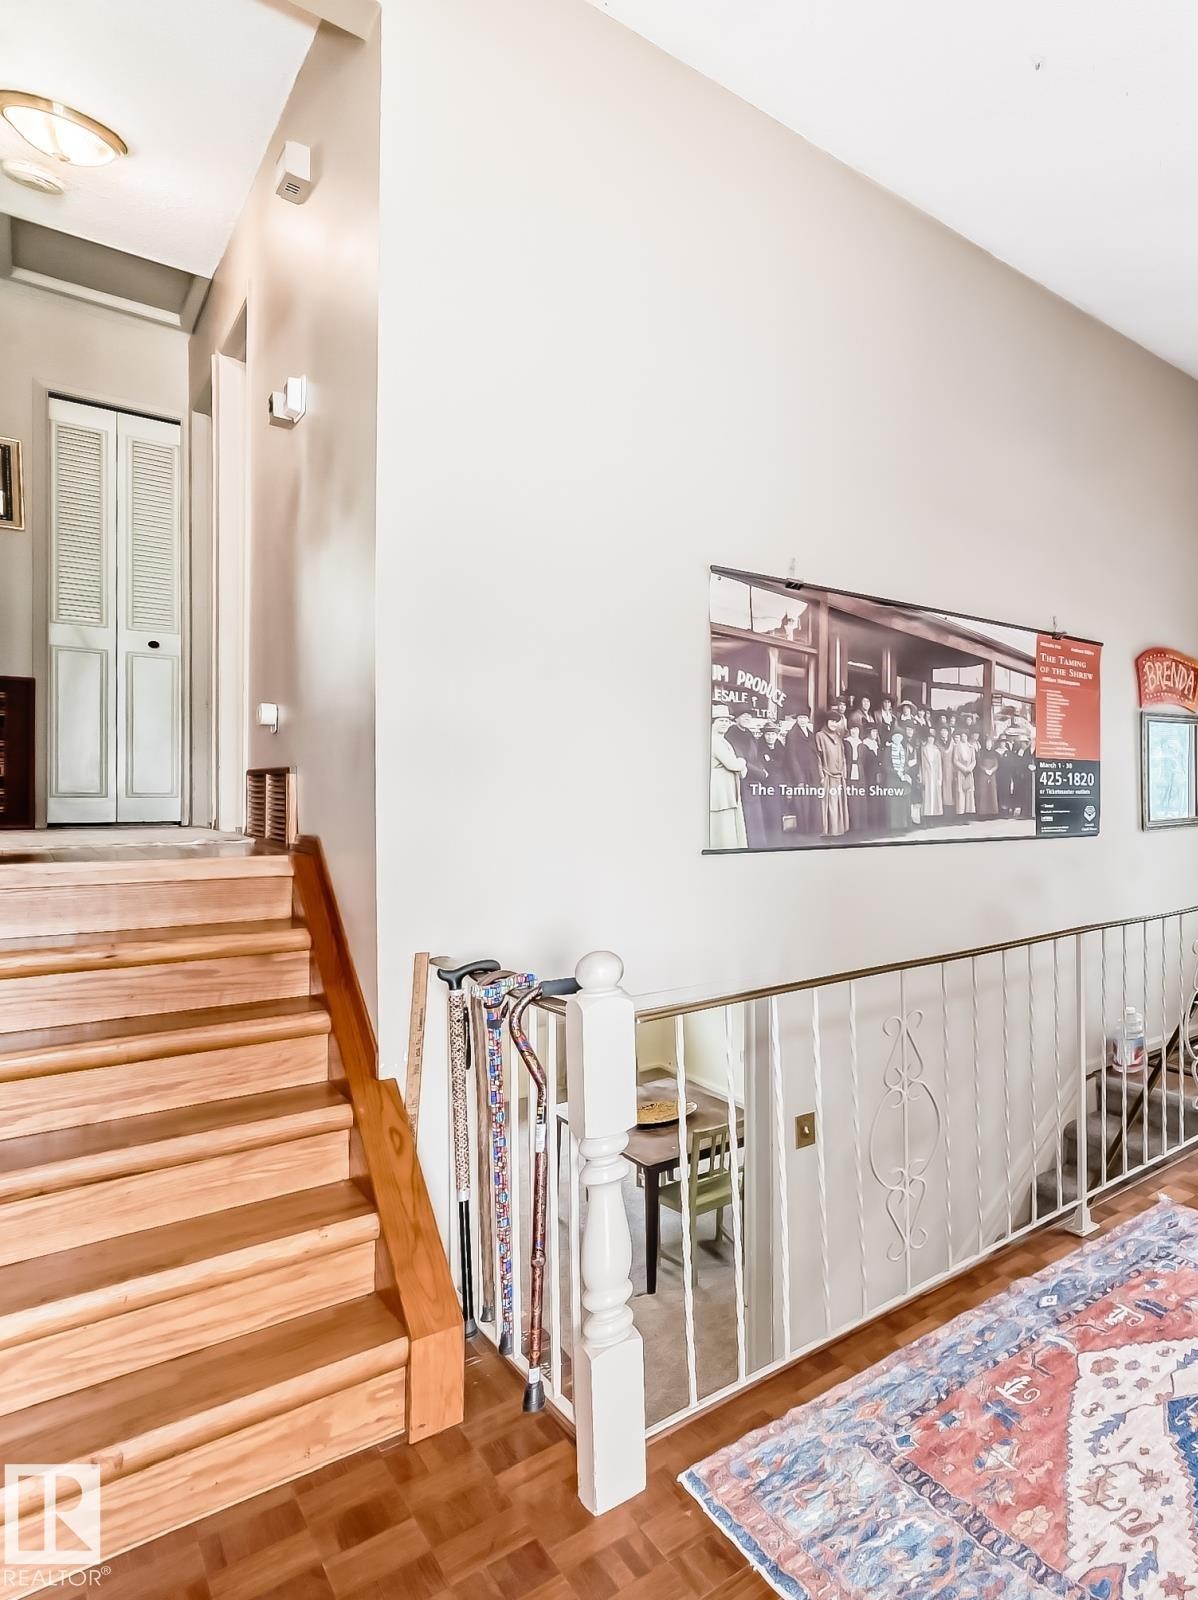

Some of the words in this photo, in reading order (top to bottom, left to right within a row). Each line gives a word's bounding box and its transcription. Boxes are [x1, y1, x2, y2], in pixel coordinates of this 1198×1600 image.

[1145, 661, 1195, 700] BRENDA
[1039, 771, 1095, 786] 425-1820
[750, 782, 775, 796] The
[779, 784, 826, 799] Taming
[829, 784, 842, 796] of
[846, 785, 866, 796] the
[869, 785, 905, 797] Shrew
